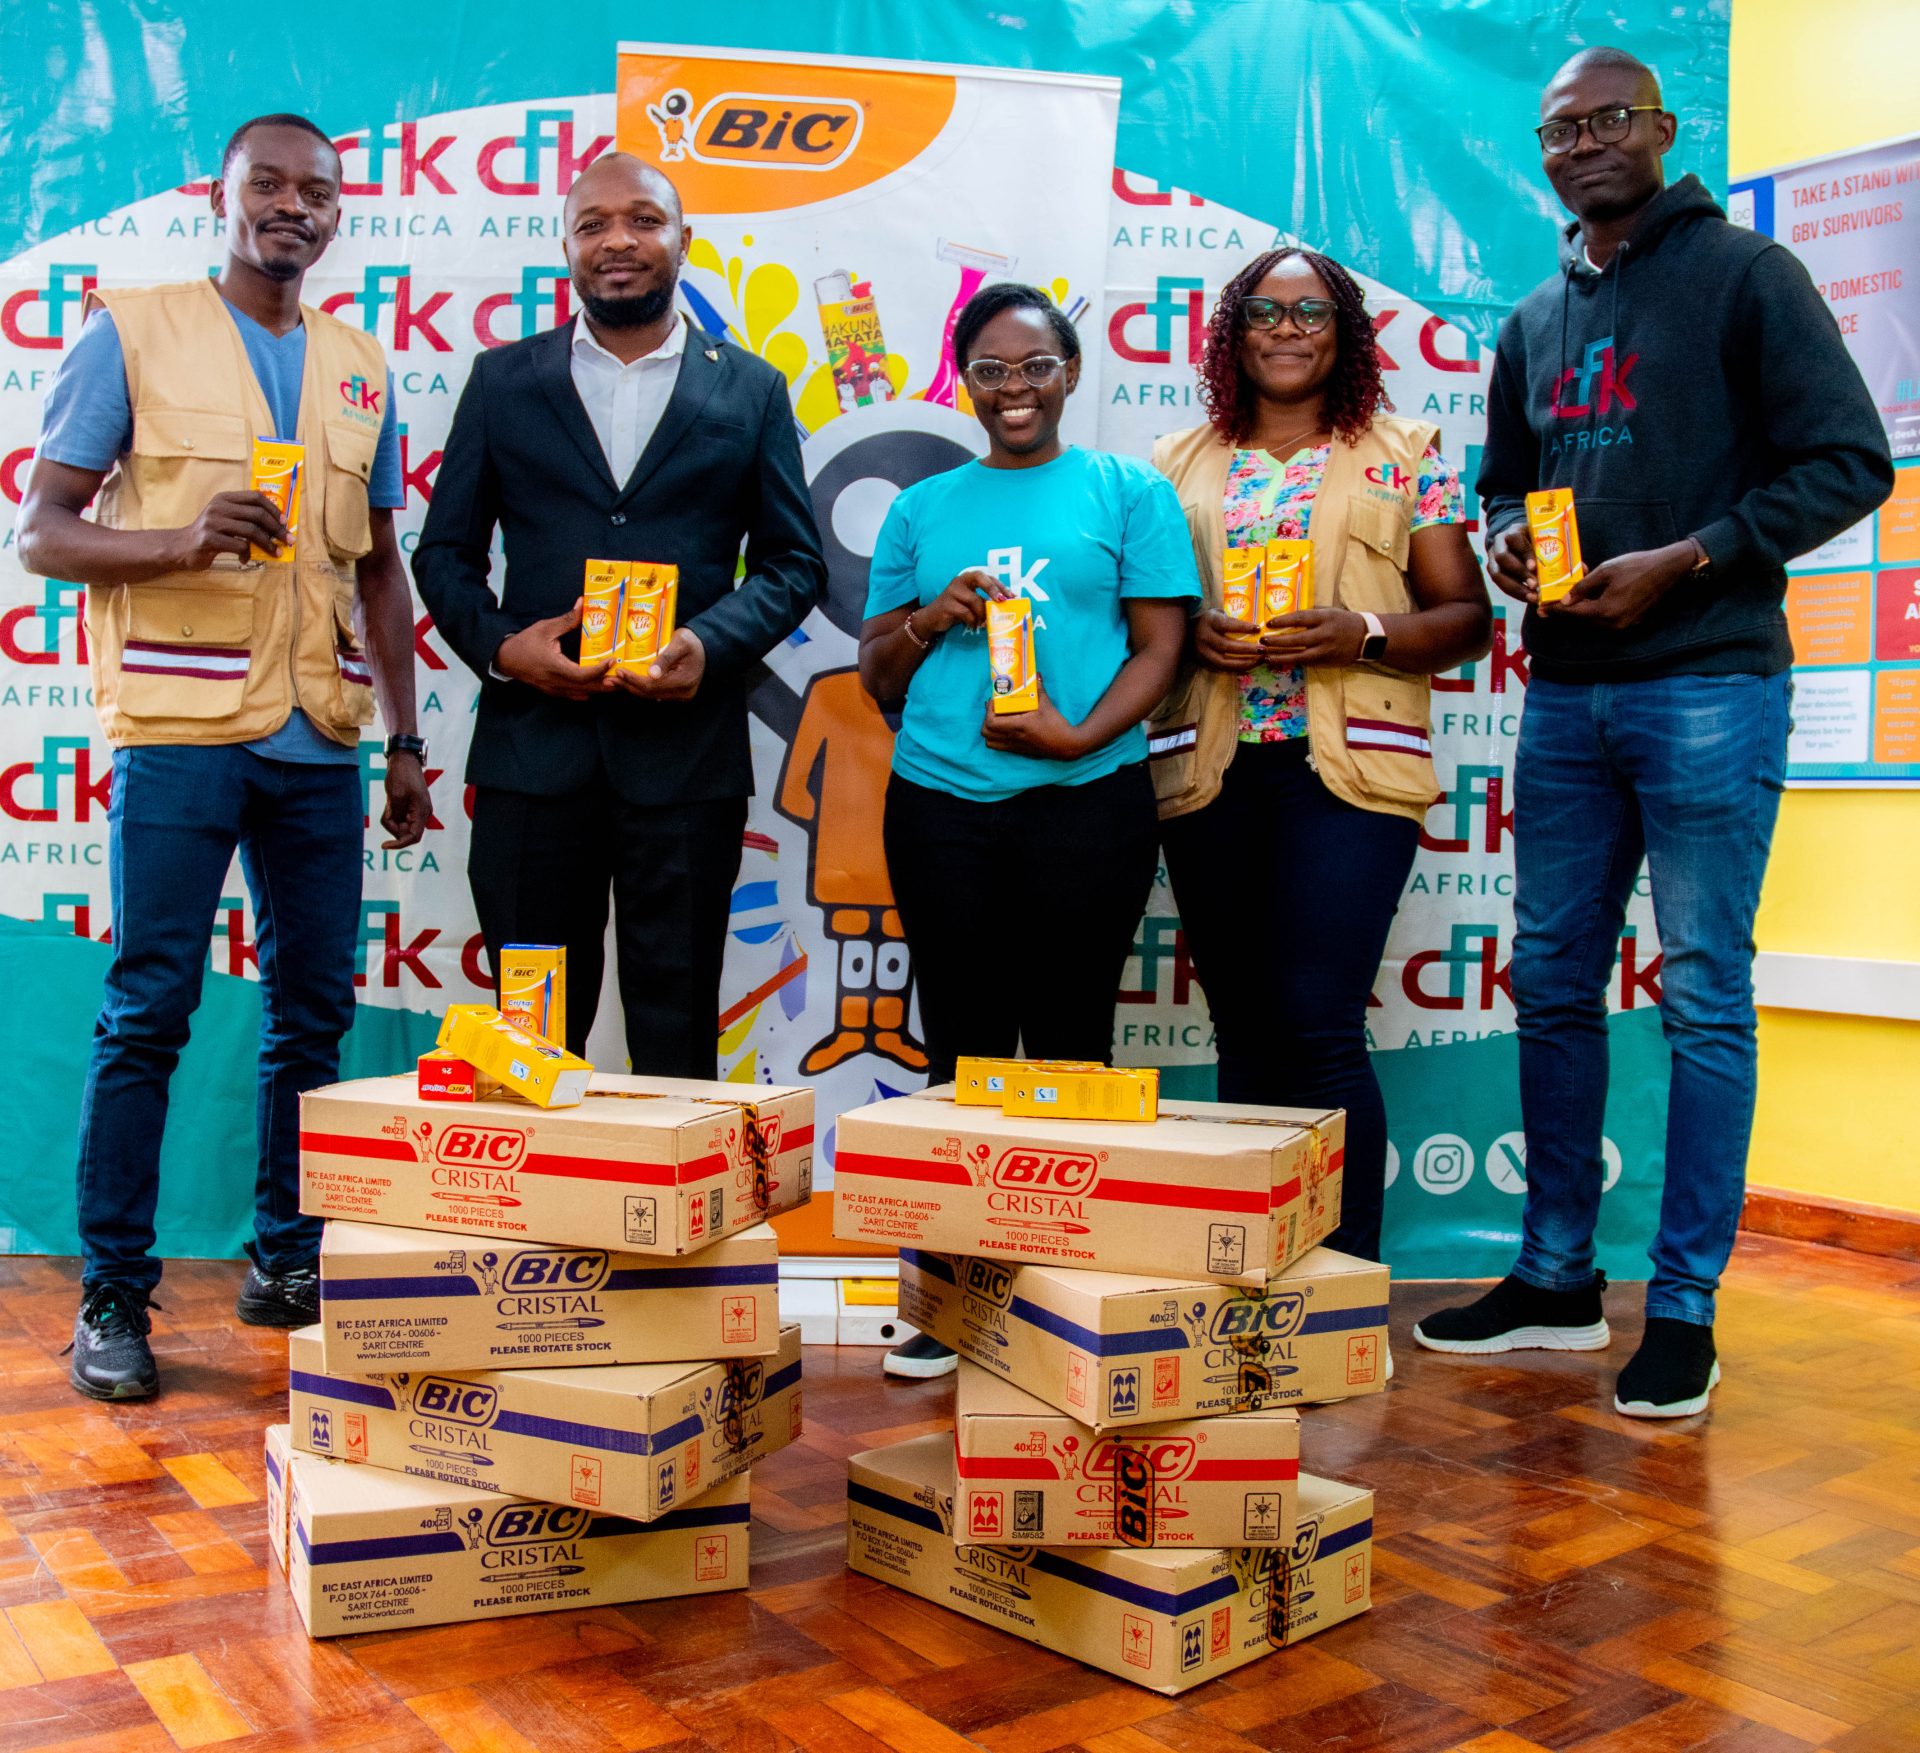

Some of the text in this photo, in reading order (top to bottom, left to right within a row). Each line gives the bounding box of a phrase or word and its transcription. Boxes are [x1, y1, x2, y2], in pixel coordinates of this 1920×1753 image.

[706, 109, 850, 152] BiC
[1792, 167, 1892, 208] TAKE A STAND
[1792, 202, 1903, 243] GBV SURVIVORS
[1113, 226, 1245, 250] AFRICA
[1830, 269, 1903, 302] DOMESTIC
[1551, 425, 1634, 455] AFRICA
[1, 843, 103, 866] AFRIC
[1410, 873, 1513, 896] AFRIC
[443, 1131, 520, 1163] BiC
[306, 1171, 392, 1187] BIC EAST AFRICA LIMITED
[431, 1168, 521, 1193] CRISTAL
[1000, 1155, 1092, 1187] BiC
[325, 1183, 341, 1192] BOX
[325, 1193, 373, 1206] SARIT CENTRE
[842, 1193, 941, 1211] BIC EAST AFRICA LIMITED
[987, 1192, 1090, 1220] CRISTAL
[425, 1213, 528, 1232] PLEASE ROTATE STOCK
[448, 1205, 504, 1219] 1000 PIECES
[863, 1206, 883, 1216] BOX
[883, 1208, 898, 1218] 764
[905, 1211, 929, 1221] 00606
[858, 1227, 923, 1241] www.bicworld.com
[863, 1216, 918, 1231] SARIT CENTRE
[979, 1239, 1096, 1260] PLEASE ROTATE STOCK
[1005, 1231, 1070, 1247] 1000 PIECES
[511, 1255, 604, 1286] BiC
[496, 1295, 604, 1316] CRISTAL
[962, 1295, 1009, 1334] CRISTAL
[336, 1317, 448, 1329] BIC EAST AFRICA LIMITED
[1150, 1312, 1175, 1324] 40x25
[1218, 1301, 1299, 1335] BiC
[363, 1331, 384, 1339] BOX
[385, 1330, 401, 1339] 764
[408, 1329, 435, 1337] 00606
[518, 1332, 585, 1343] 1000 PIECES
[356, 1350, 430, 1360] www.bicworld.com
[362, 1340, 424, 1350] SARIT CENTRE
[490, 1342, 612, 1355] PLEASE ROTATE STOCK
[958, 1339, 1011, 1373] PLEASE STOCK
[420, 1383, 494, 1417] BiC
[1196, 1388, 1303, 1409] PLEASE STOCK
[409, 1420, 493, 1451] CRISTAL
[1014, 1443, 1043, 1452] 40x25
[404, 1465, 500, 1491] PLEASE ROTATE STOCK
[425, 1459, 478, 1477] 1000 PIECES
[494, 1507, 581, 1539] BiC
[864, 1524, 877, 1533] EAST
[878, 1532, 899, 1543] AFRICA
[900, 1538, 922, 1552] LIMITED
[1011, 1531, 1045, 1540] SM#582
[481, 1544, 584, 1569] CRISTAL
[955, 1546, 1030, 1587] CRISTAL
[322, 1574, 433, 1593] BIC EAST AFRICA LIMITED
[349, 1591, 369, 1601] BOX
[370, 1589, 386, 1599] 764
[393, 1586, 420, 1597] 00606
[500, 1579, 565, 1594] 1000 PIECES
[347, 1598, 408, 1612] SARIT CENTRE
[473, 1587, 591, 1608] PLEASE ROTATE STOCK
[968, 1583, 1015, 1608] 1000 PIECES
[342, 1608, 415, 1621] www.bicworld.com
[949, 1586, 1035, 1627] PLEASE ROTATE STOCK
